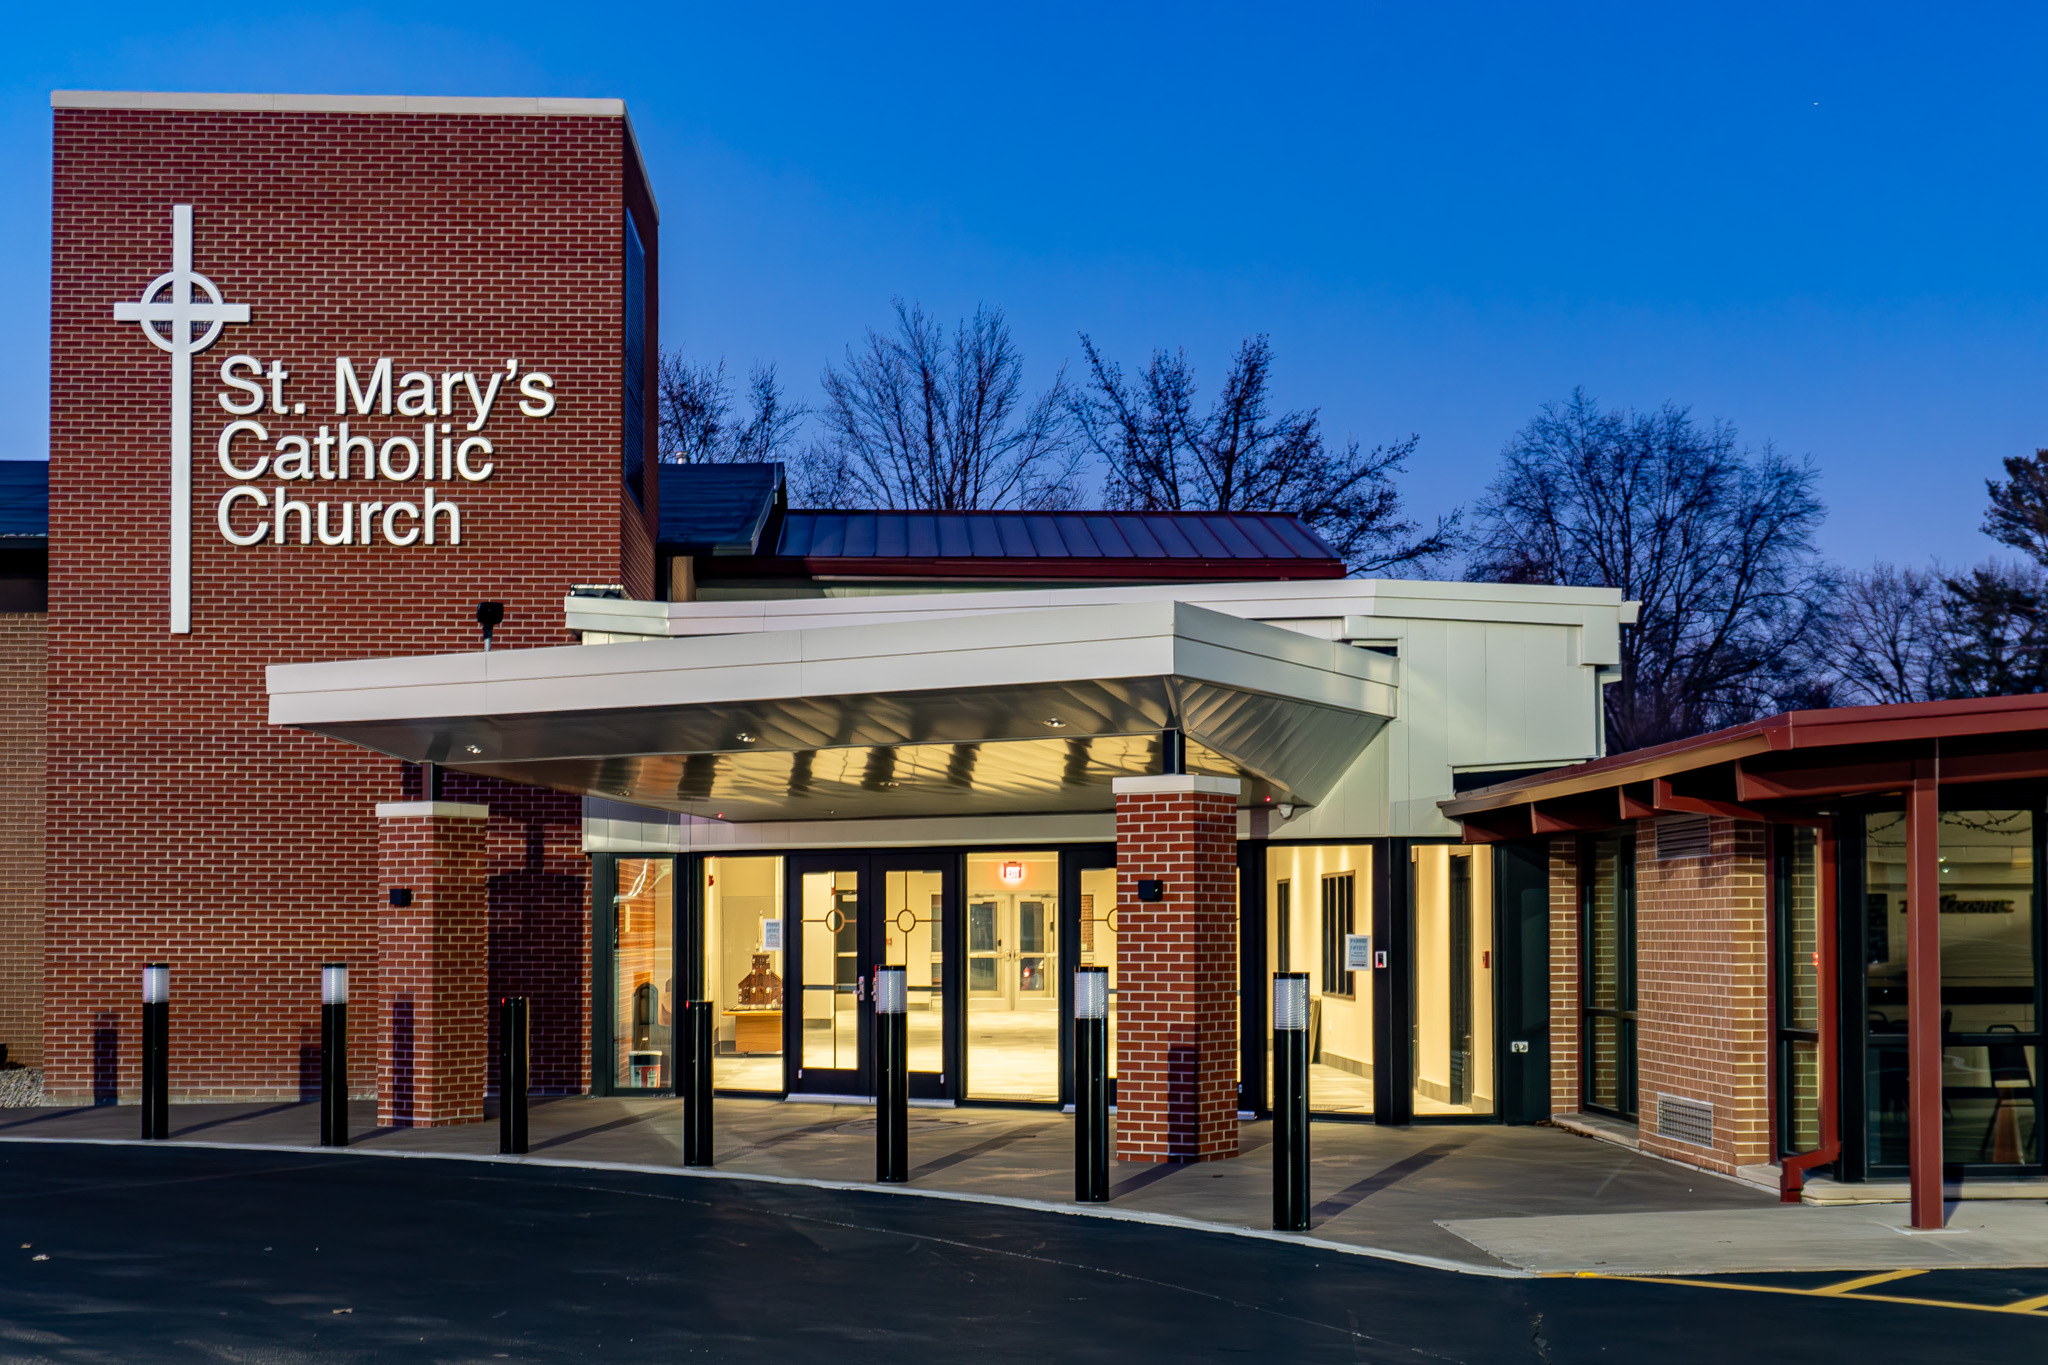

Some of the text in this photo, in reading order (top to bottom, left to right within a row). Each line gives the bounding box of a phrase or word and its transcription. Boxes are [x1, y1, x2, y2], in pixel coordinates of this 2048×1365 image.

[217, 354, 556, 432] St. Mary’s
[217, 419, 494, 482] Catholic
[217, 485, 462, 546] Church
